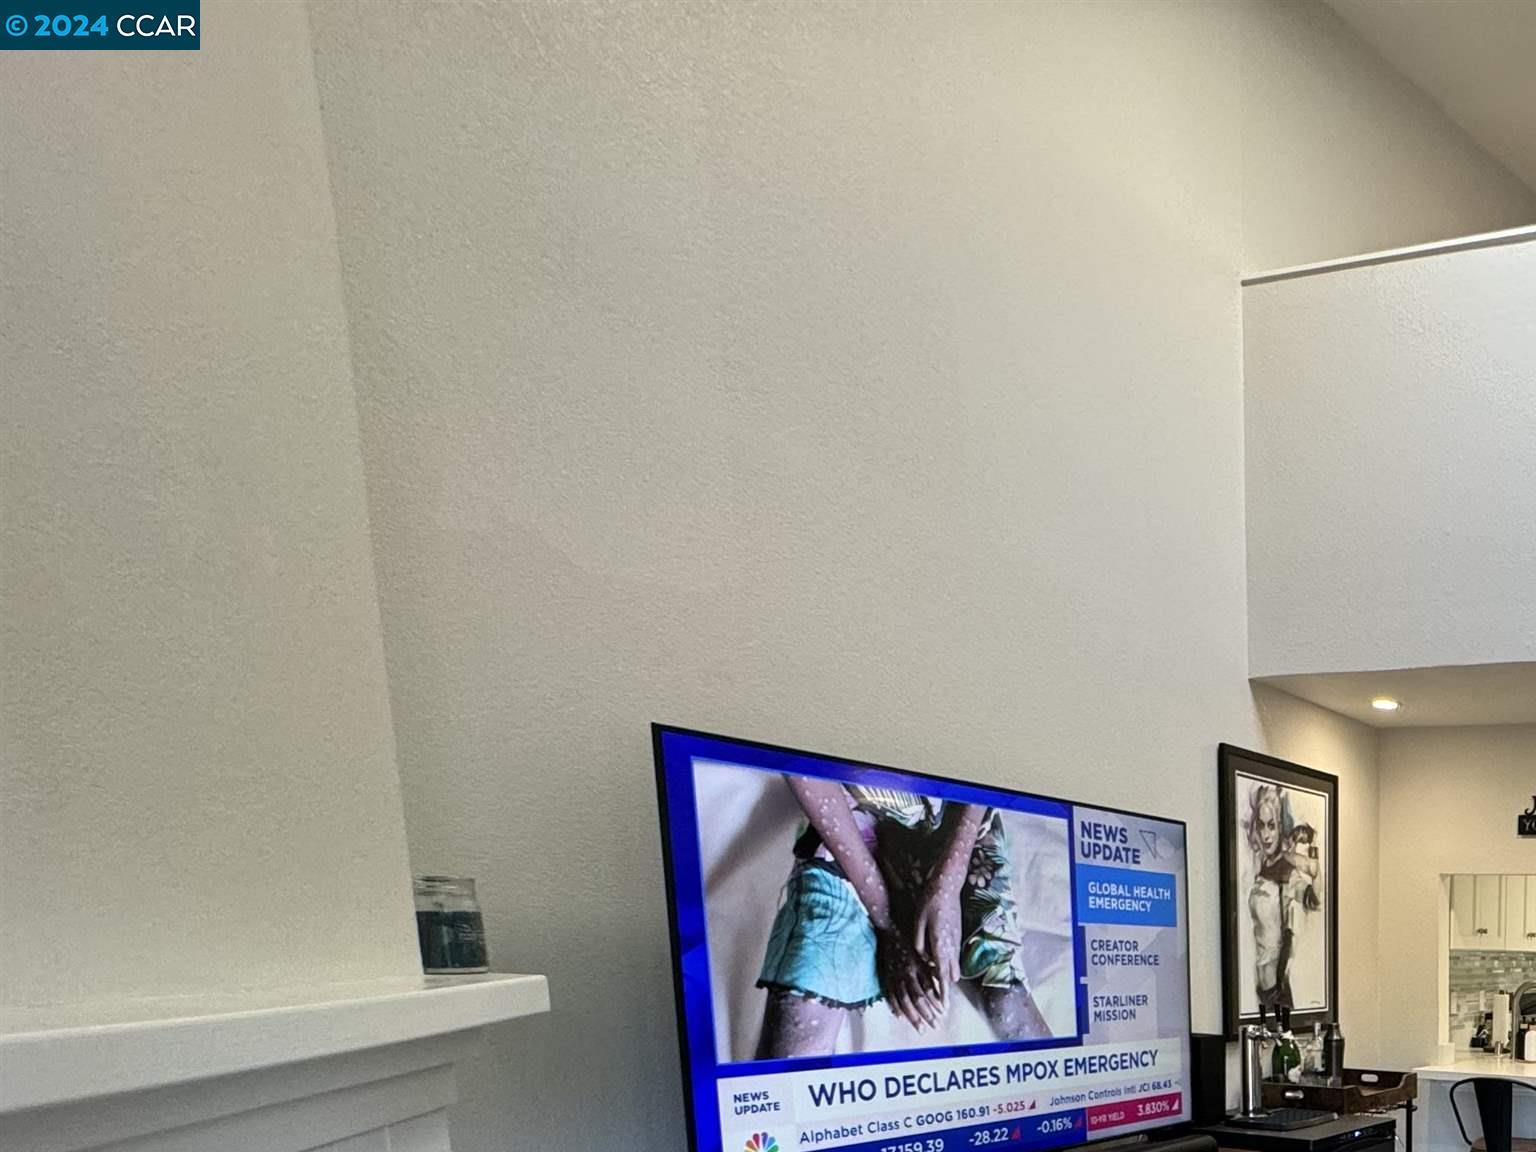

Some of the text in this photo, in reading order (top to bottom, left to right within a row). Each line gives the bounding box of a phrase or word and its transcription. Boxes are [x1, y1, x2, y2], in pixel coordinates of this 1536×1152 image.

[1081, 820, 1128, 844] NEWS
[1081, 841, 1141, 864] UPDATE
[1088, 881, 1171, 900] GLOBAL HEALTH
[1088, 895, 1152, 912] EMERGENCY
[1090, 939, 1139, 952] CREATOR
[1091, 954, 1160, 966] CONFERENCE
[1093, 994, 1148, 1008] STARLINER
[1093, 1009, 1136, 1022] MISSION
[808, 1049, 1158, 1107] WHO DECLARES MPOX EMERGENCY
[733, 1091, 769, 1103] NEWS
[1049, 1093, 1086, 1106] Johnson
[1088, 1087, 1122, 1101] Controls
[734, 1101, 781, 1116] UPDATE
[1109, 1111, 1126, 1121] YIELD
[1137, 1099, 1170, 1117] 3.830%
[800, 1100, 1025, 1144] Alphabet Class C GOOG 160.91 -5.025
[968, 1127, 1009, 1146] -28.22
[1036, 1116, 1073, 1134] -0.16%
